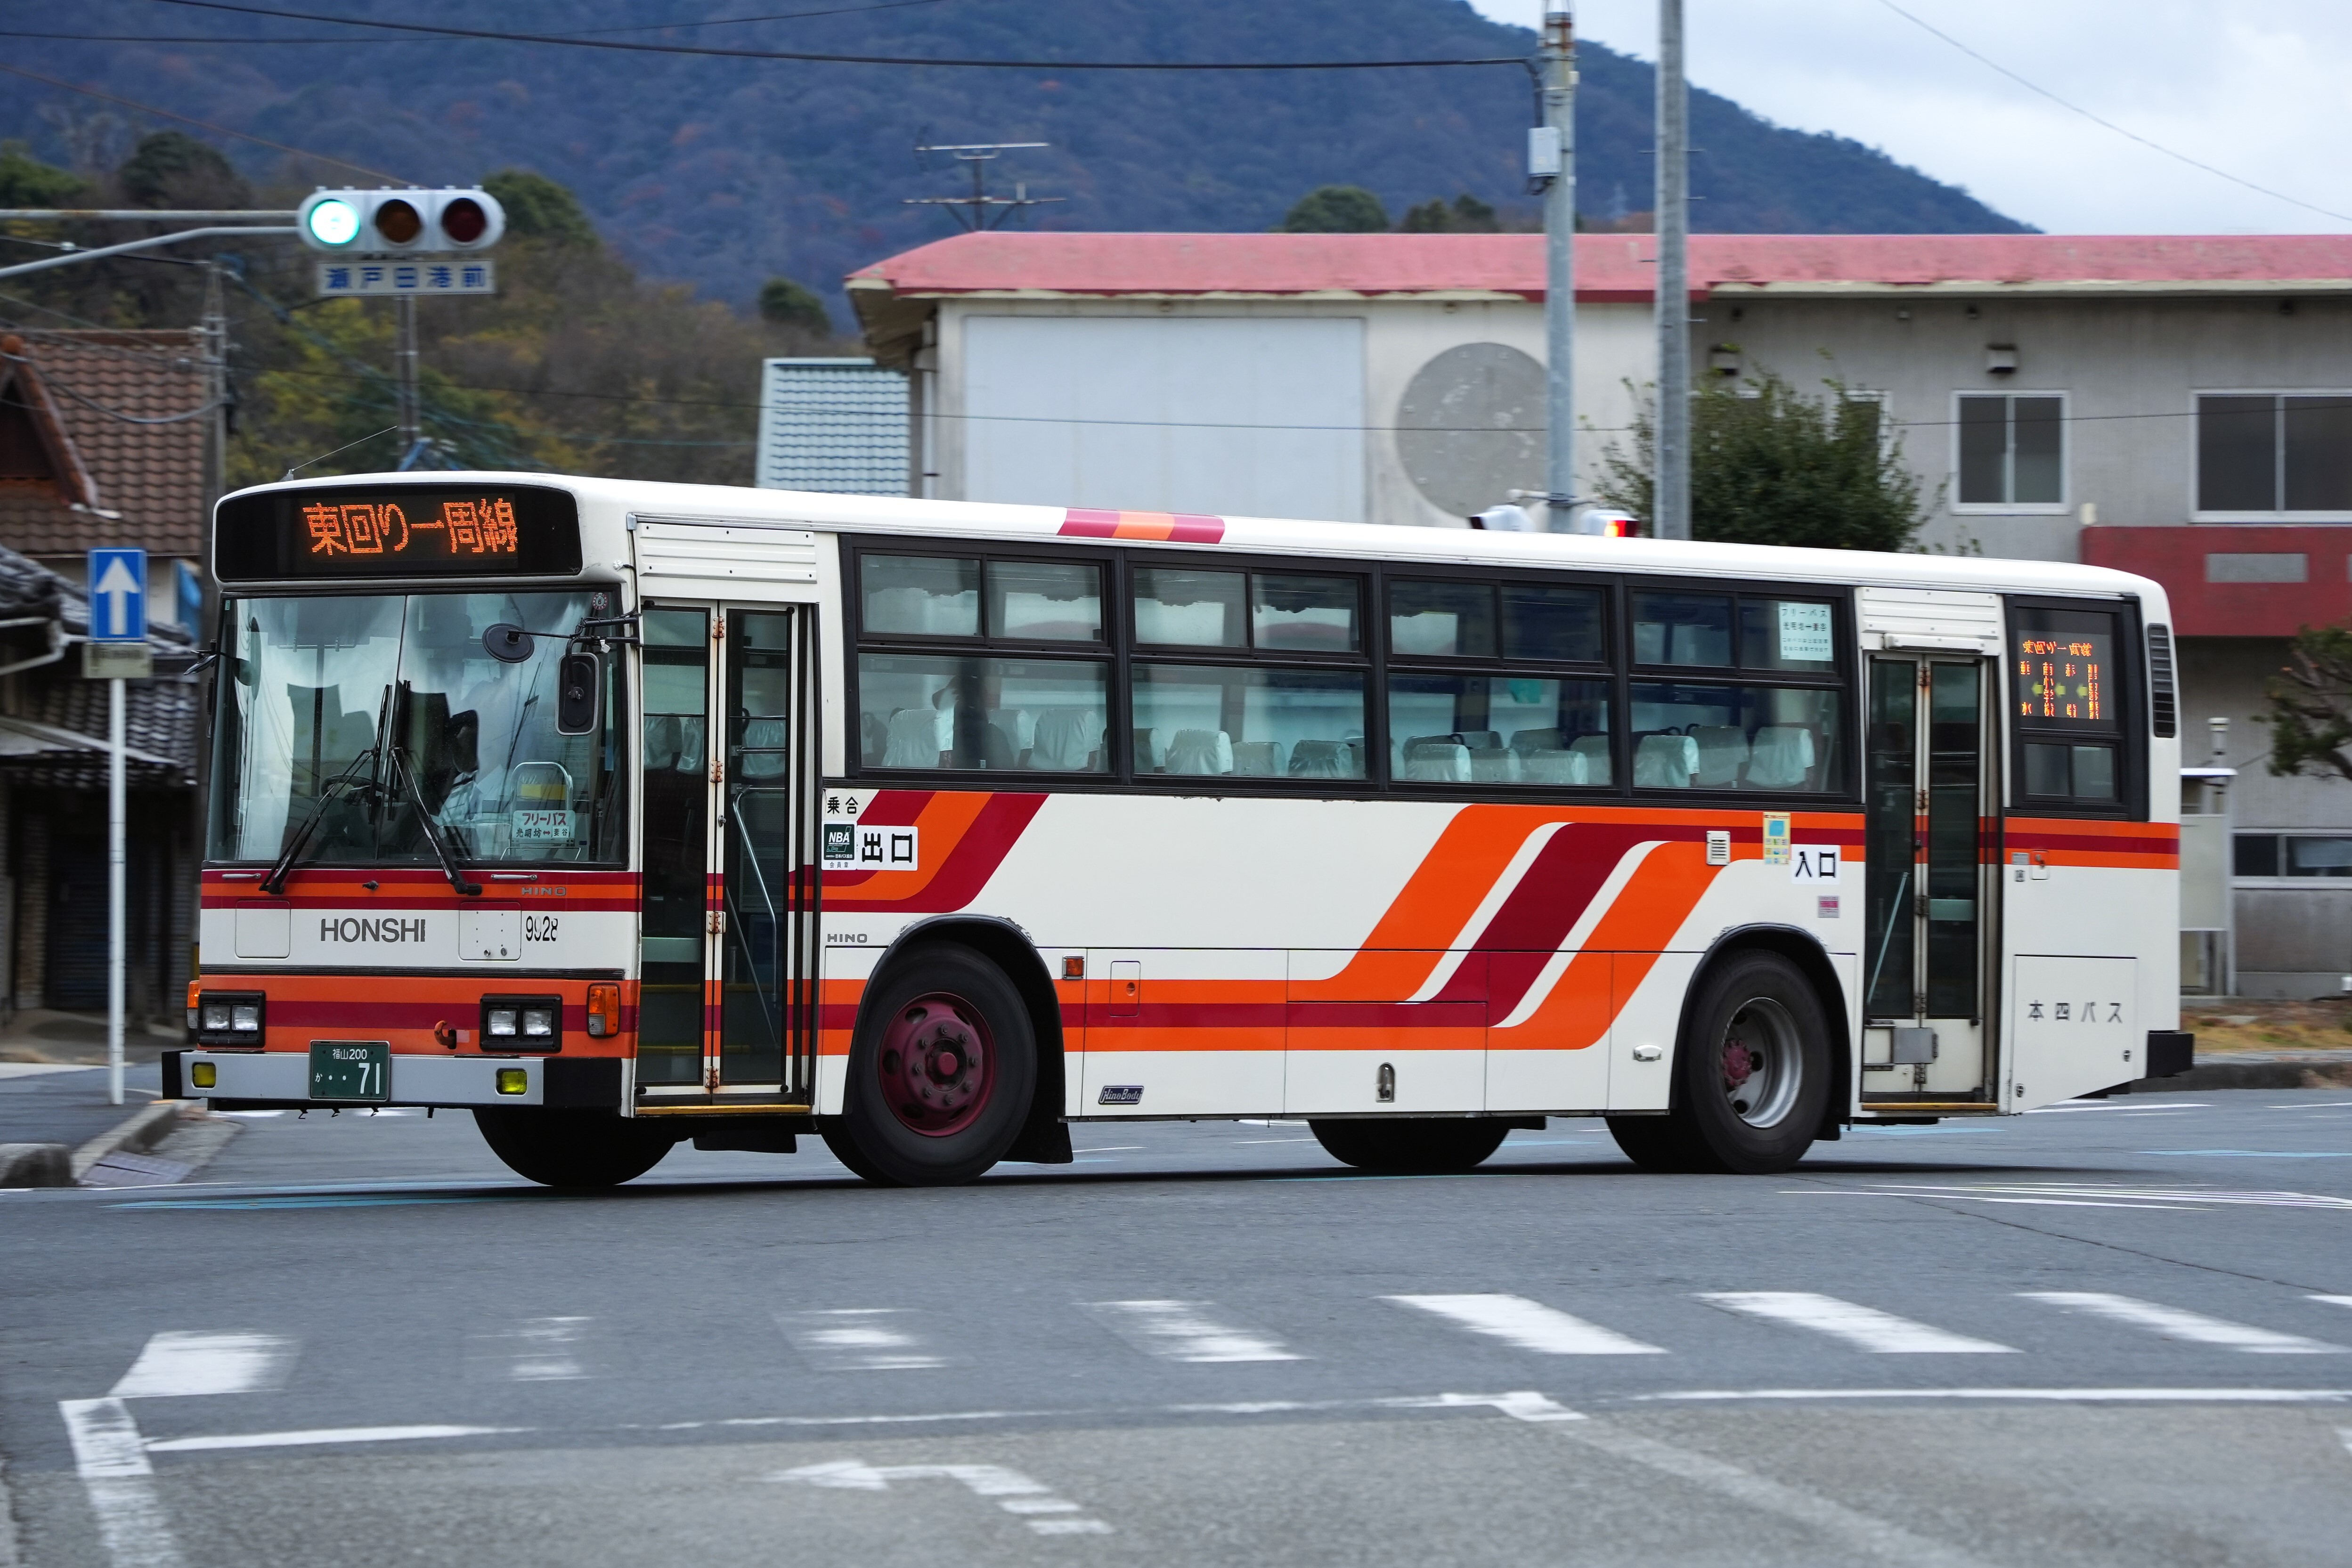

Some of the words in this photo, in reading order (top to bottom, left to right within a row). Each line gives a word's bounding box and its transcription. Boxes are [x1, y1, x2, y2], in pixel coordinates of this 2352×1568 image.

[302, 498, 517, 555] 東回り一周線
[2023, 640, 2092, 657] 東回り一周線
[827, 796, 858, 814] 乗合
[522, 812, 567, 826] フリーバス
[516, 828, 542, 837] 光明坊
[829, 832, 850, 843] NBA
[862, 832, 913, 863] 出口
[1795, 851, 1836, 878] 入口
[521, 886, 567, 896] HINO
[321, 918, 425, 942] HONSHI
[827, 934, 868, 943] HINO
[2027, 999, 2123, 1024] 本四バス
